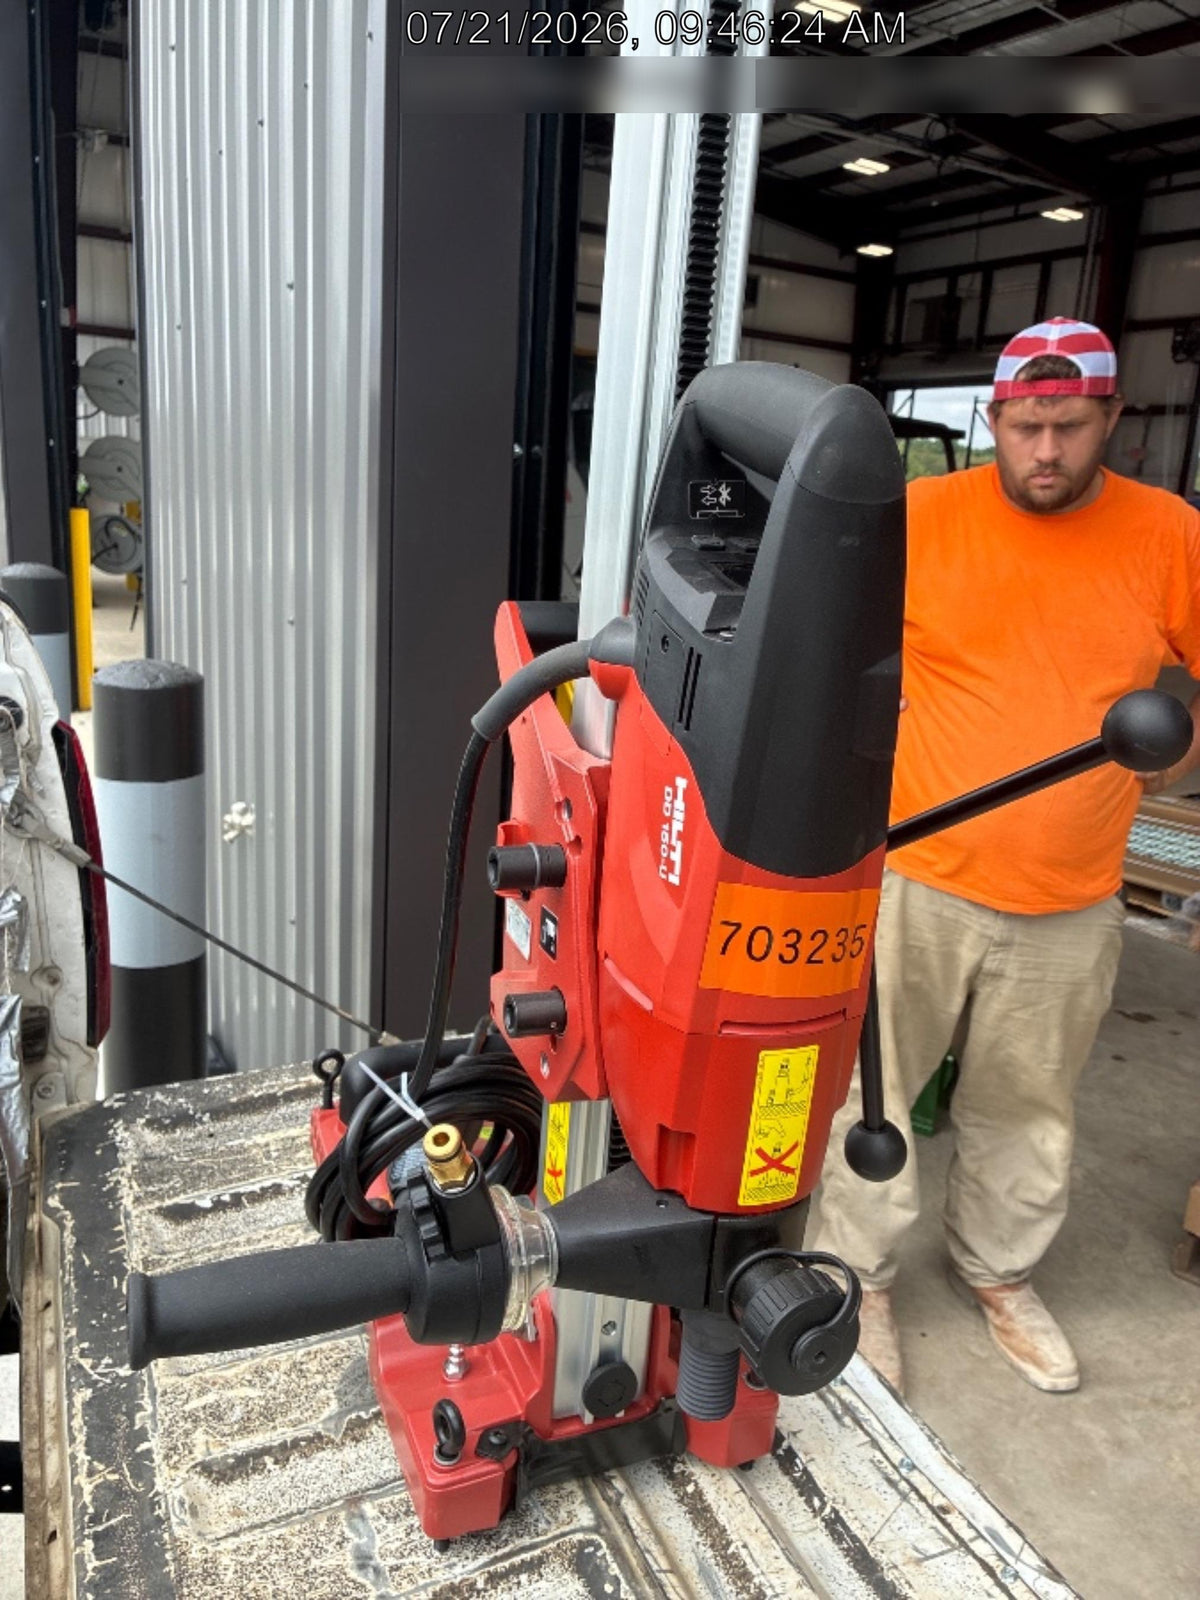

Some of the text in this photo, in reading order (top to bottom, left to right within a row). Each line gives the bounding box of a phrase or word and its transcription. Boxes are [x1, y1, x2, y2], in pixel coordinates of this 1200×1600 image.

[663, 786, 673, 817] DD
[668, 776, 687, 885] HILTI
[720, 921, 867, 964] 703235
